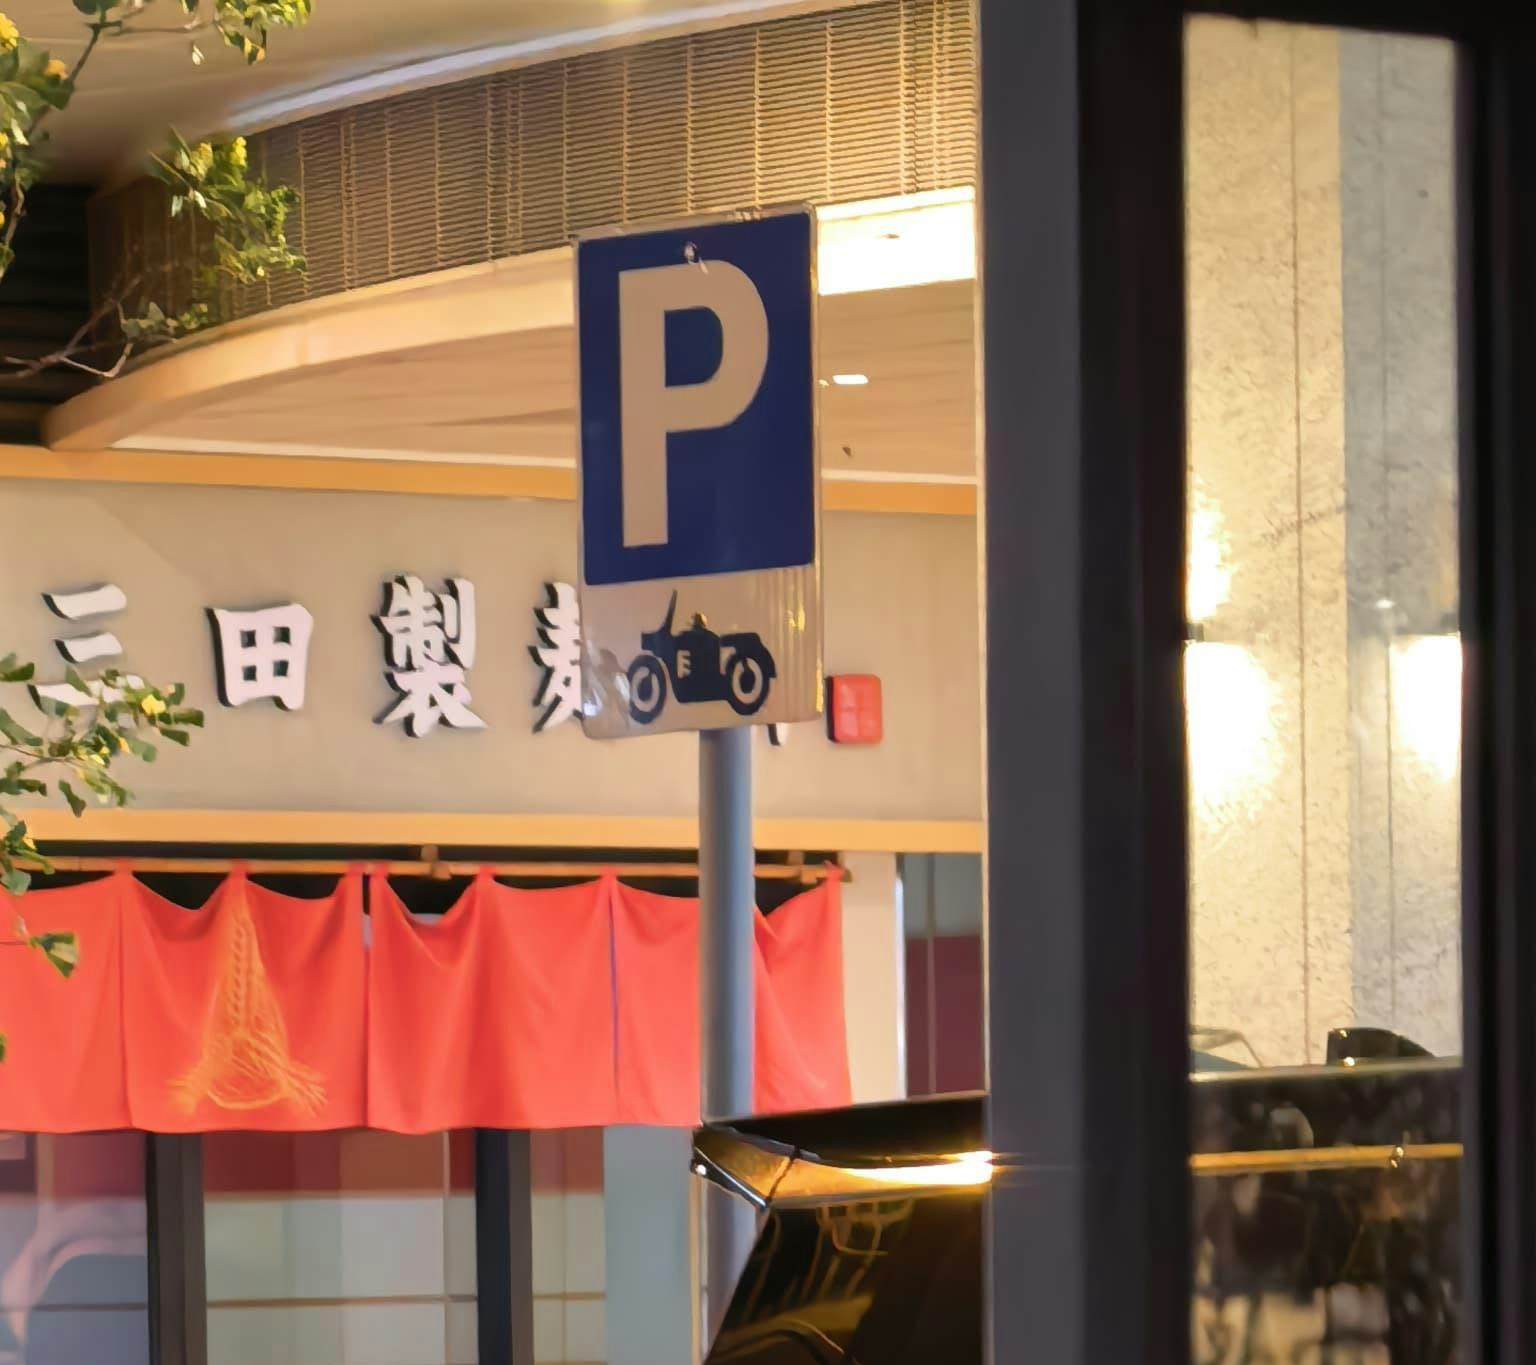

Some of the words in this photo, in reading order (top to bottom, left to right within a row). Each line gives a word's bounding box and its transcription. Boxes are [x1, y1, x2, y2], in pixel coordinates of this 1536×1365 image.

[618, 259, 769, 549] P
[27, 573, 582, 738] 三田製
